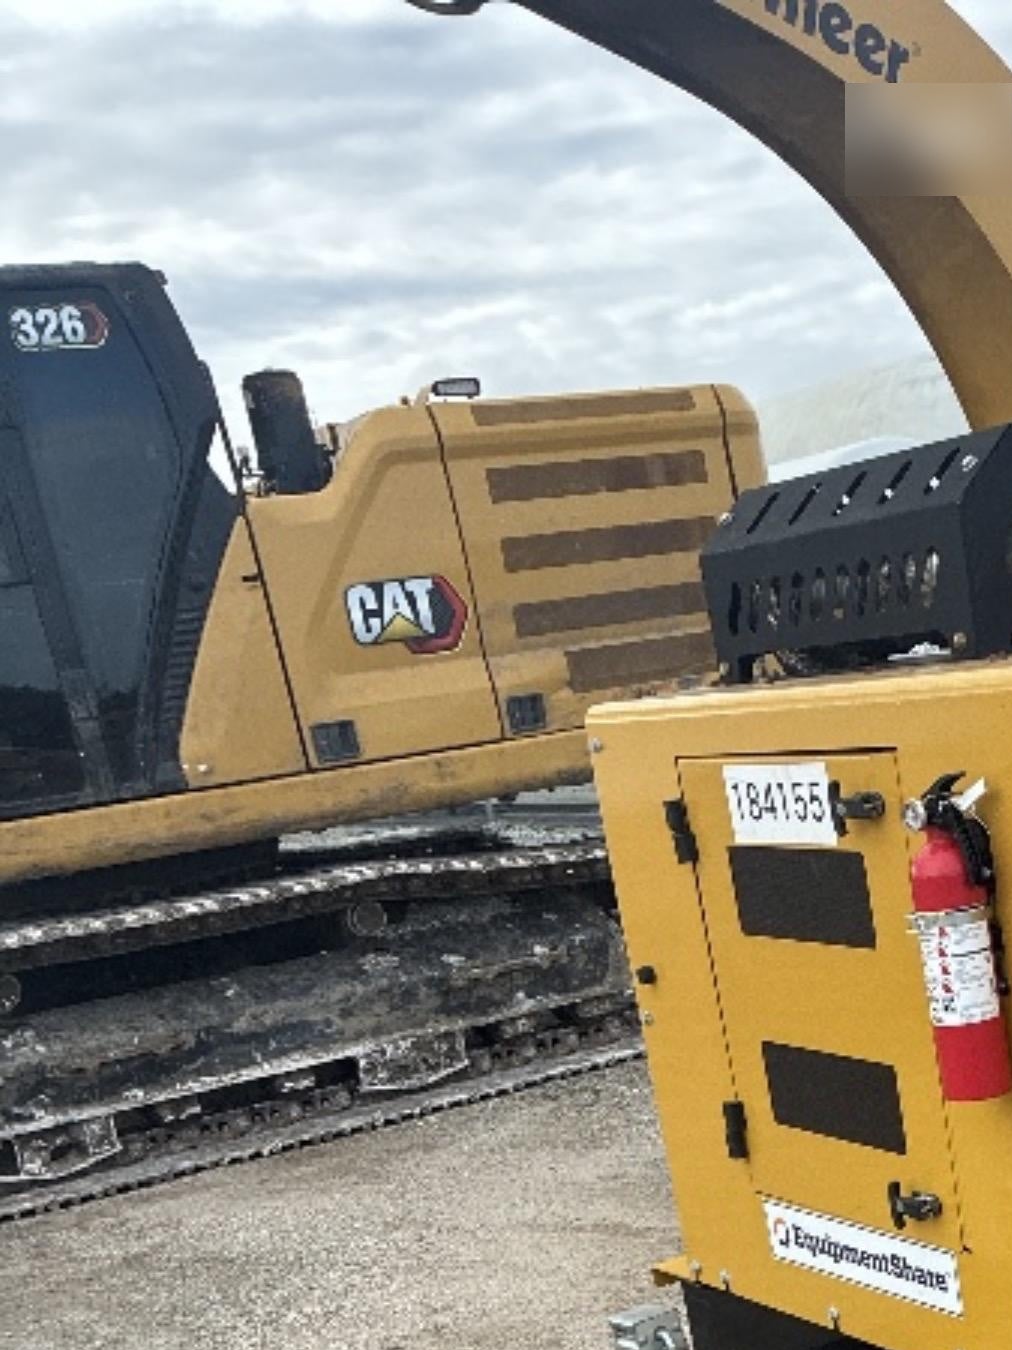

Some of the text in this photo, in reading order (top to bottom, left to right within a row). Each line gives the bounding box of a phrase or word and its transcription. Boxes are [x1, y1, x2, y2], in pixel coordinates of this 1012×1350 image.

[11, 305, 85, 345] 326
[346, 577, 436, 644] CAT
[731, 782, 825, 822] 184155
[791, 1223, 949, 1293] EquipmentShare
